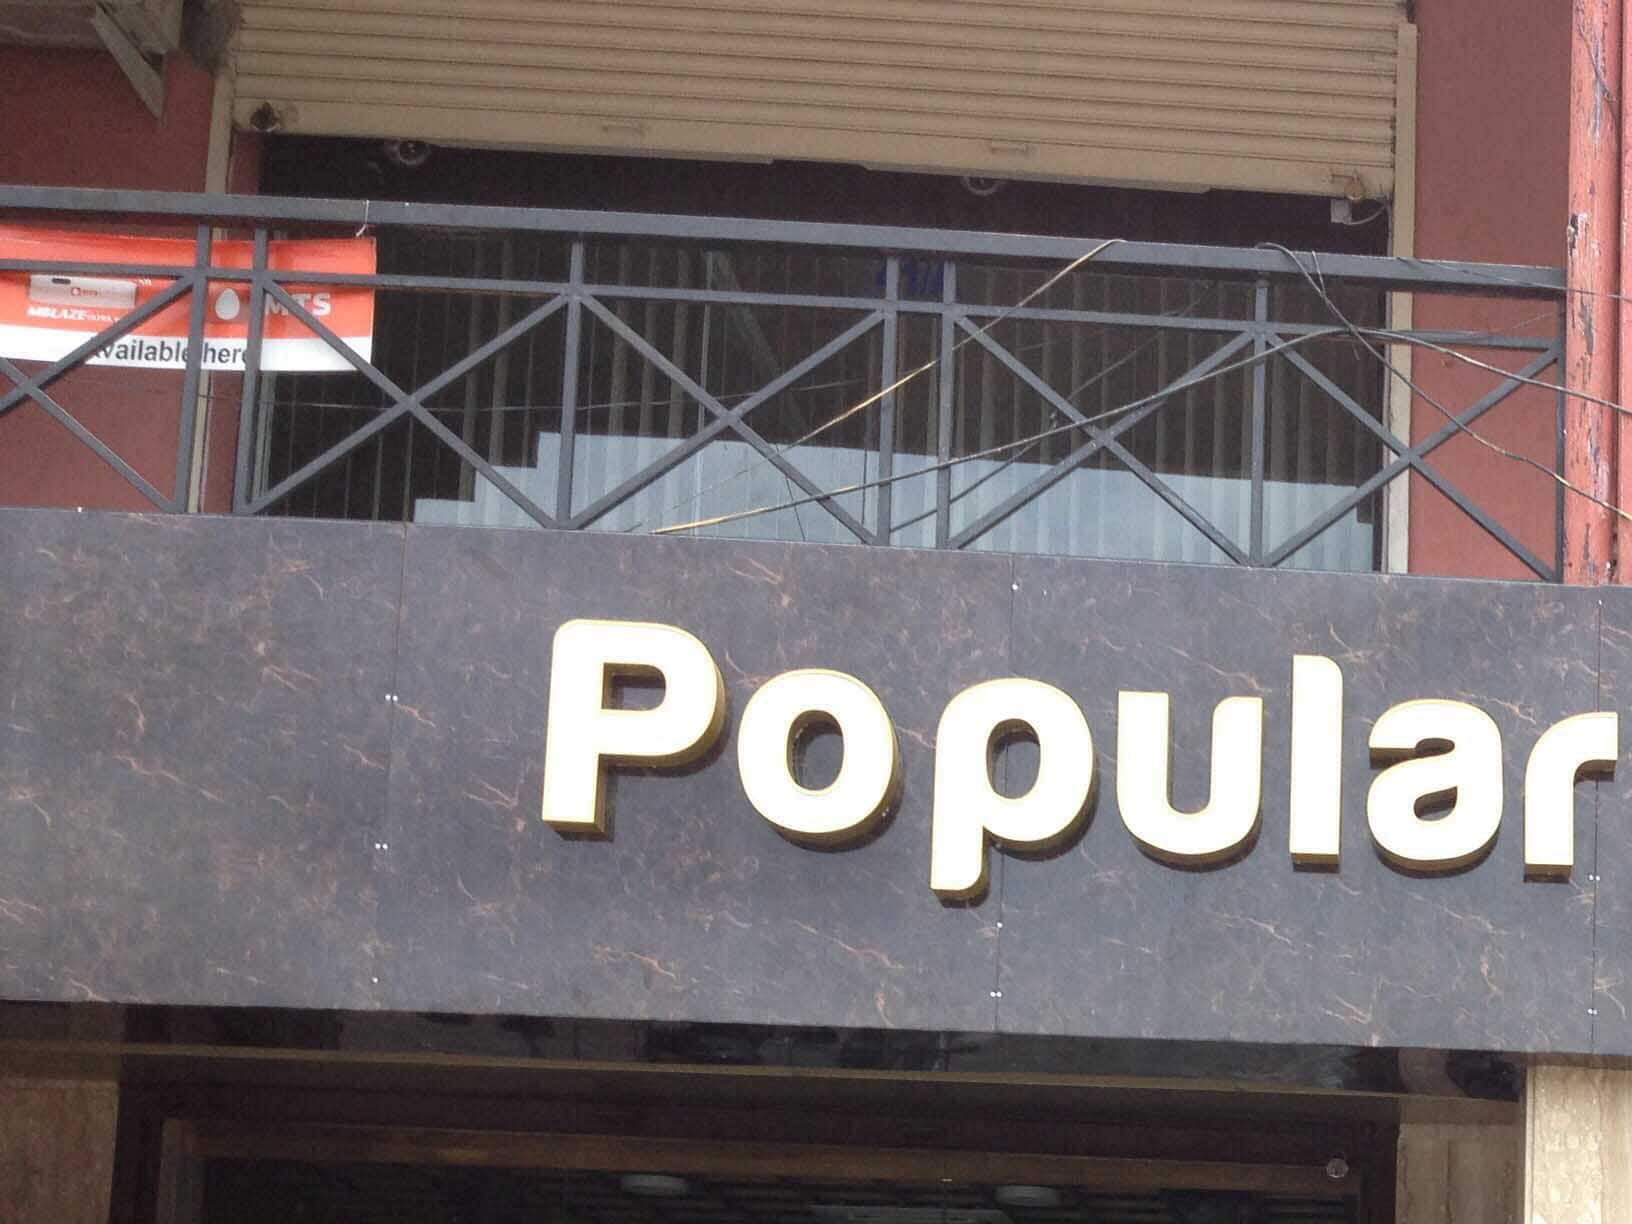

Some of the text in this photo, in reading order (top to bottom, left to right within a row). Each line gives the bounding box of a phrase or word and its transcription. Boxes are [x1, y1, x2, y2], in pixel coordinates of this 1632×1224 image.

[264, 292, 332, 317] MTS
[95, 339, 189, 362] vailable
[541, 618, 1620, 901] Popular
